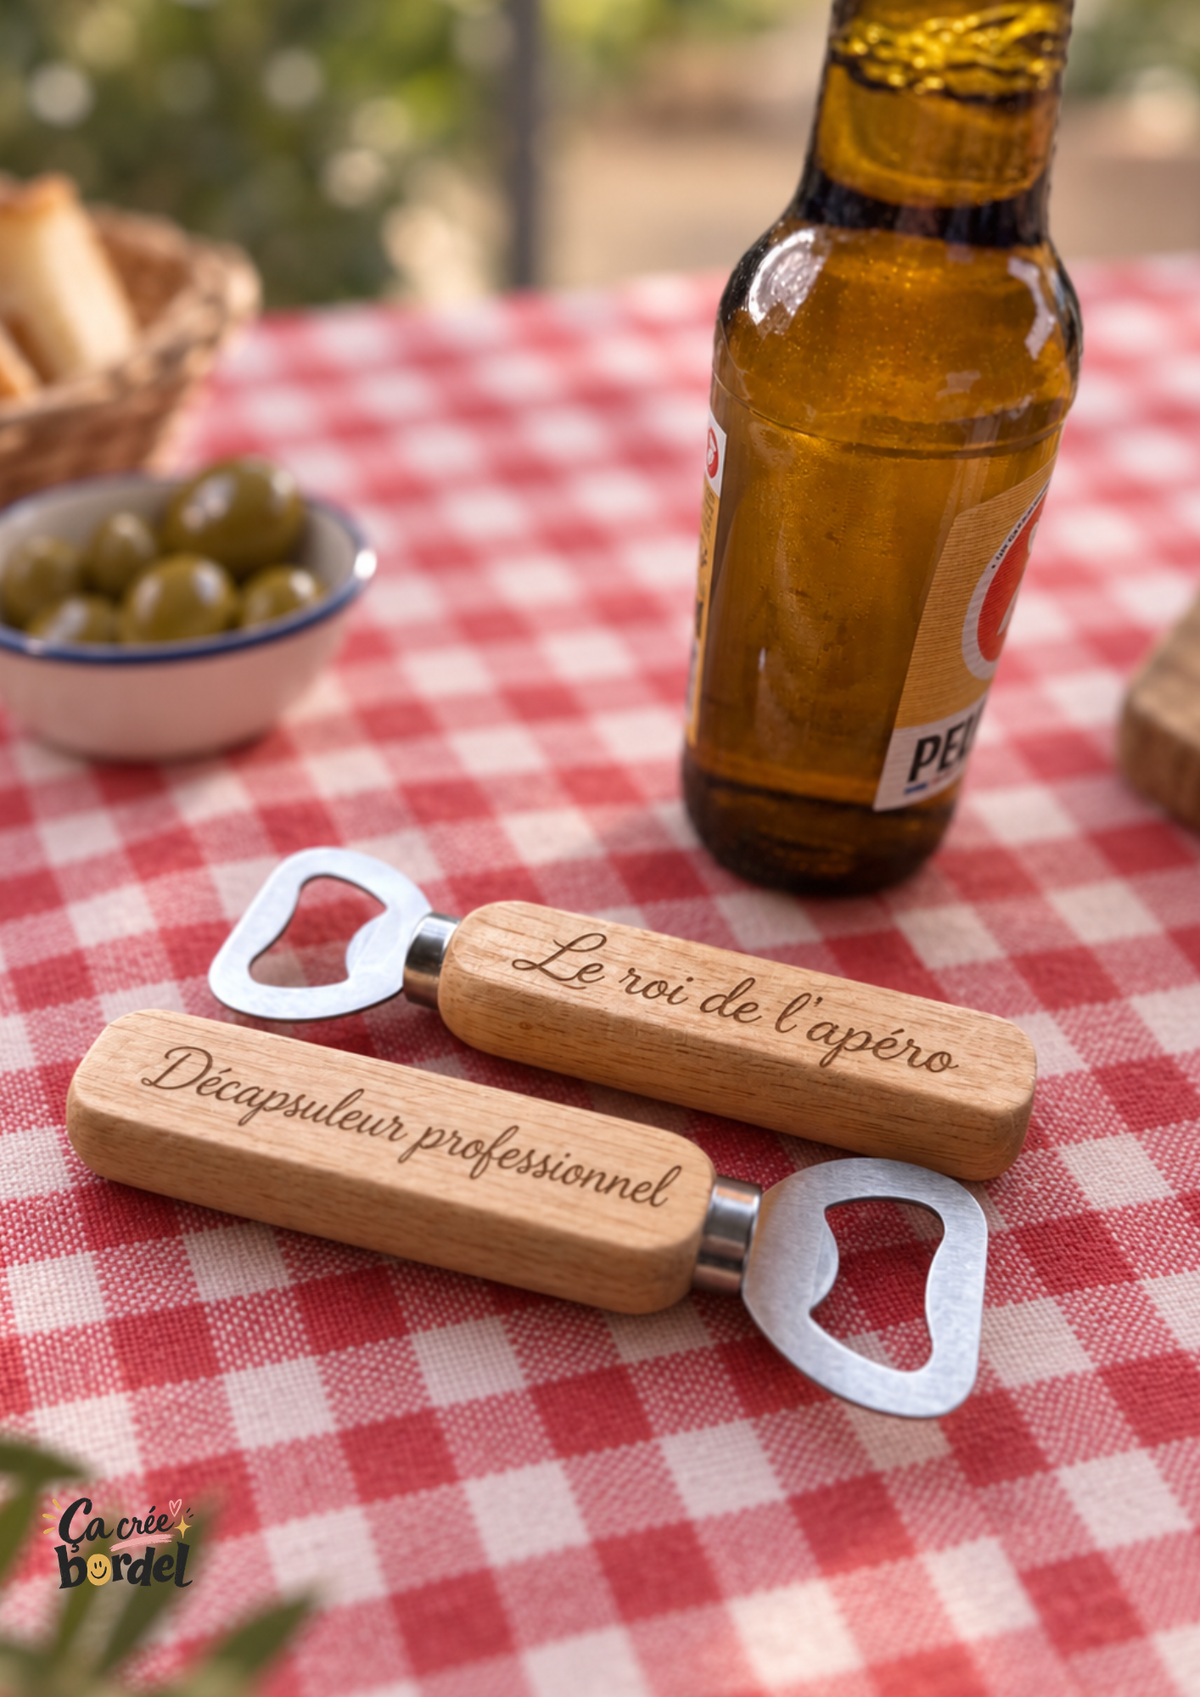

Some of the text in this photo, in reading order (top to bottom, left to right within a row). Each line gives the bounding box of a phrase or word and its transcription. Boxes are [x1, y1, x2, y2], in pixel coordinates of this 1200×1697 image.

[511, 932, 959, 1073] Le roi de l'apéro
[141, 1045, 683, 1208] Décapsuleur professionnel
